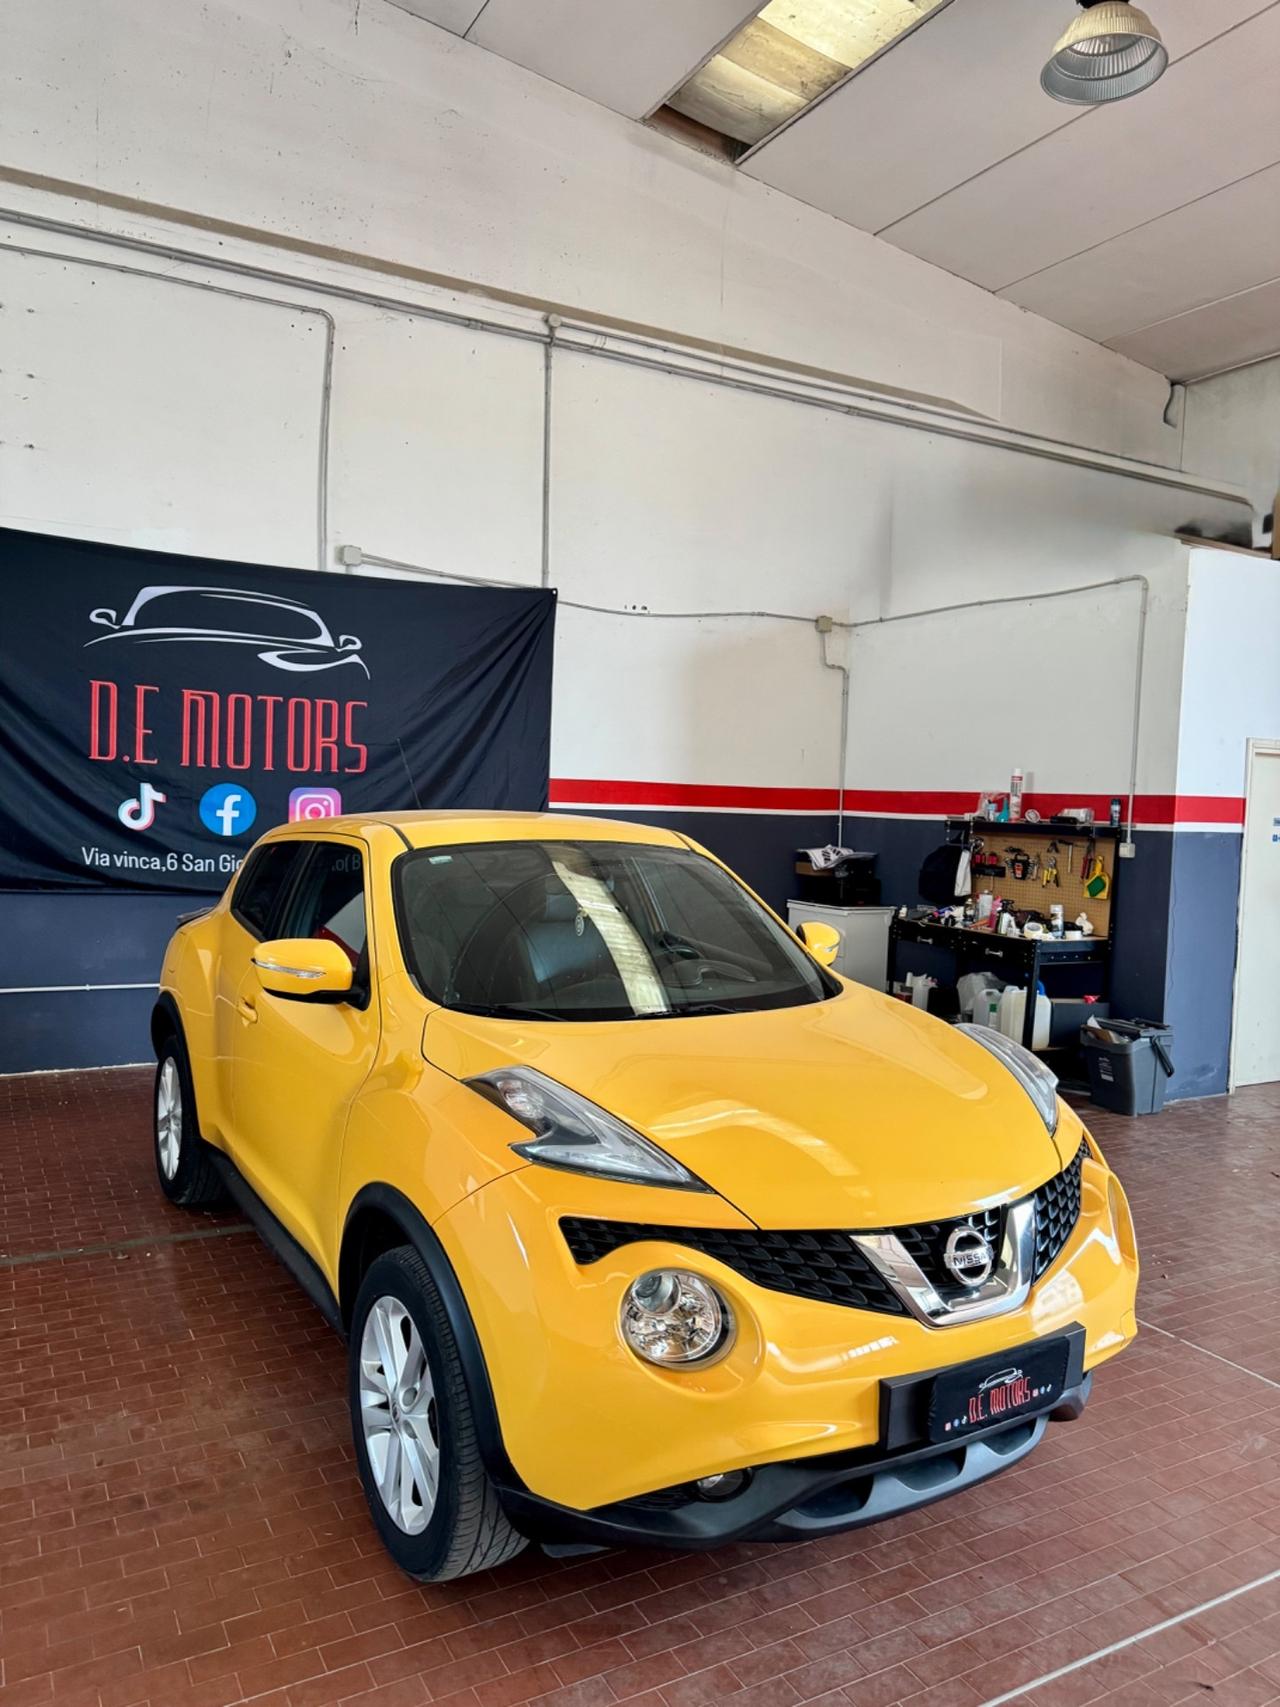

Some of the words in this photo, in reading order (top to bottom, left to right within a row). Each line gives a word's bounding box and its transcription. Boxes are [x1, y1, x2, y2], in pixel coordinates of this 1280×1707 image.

[89, 680, 160, 764] D.E
[180, 689, 368, 772] MOTORS
[82, 847, 110, 866] Via
[182, 853, 215, 872] San
[989, 1376, 1031, 1415] MOTORS
